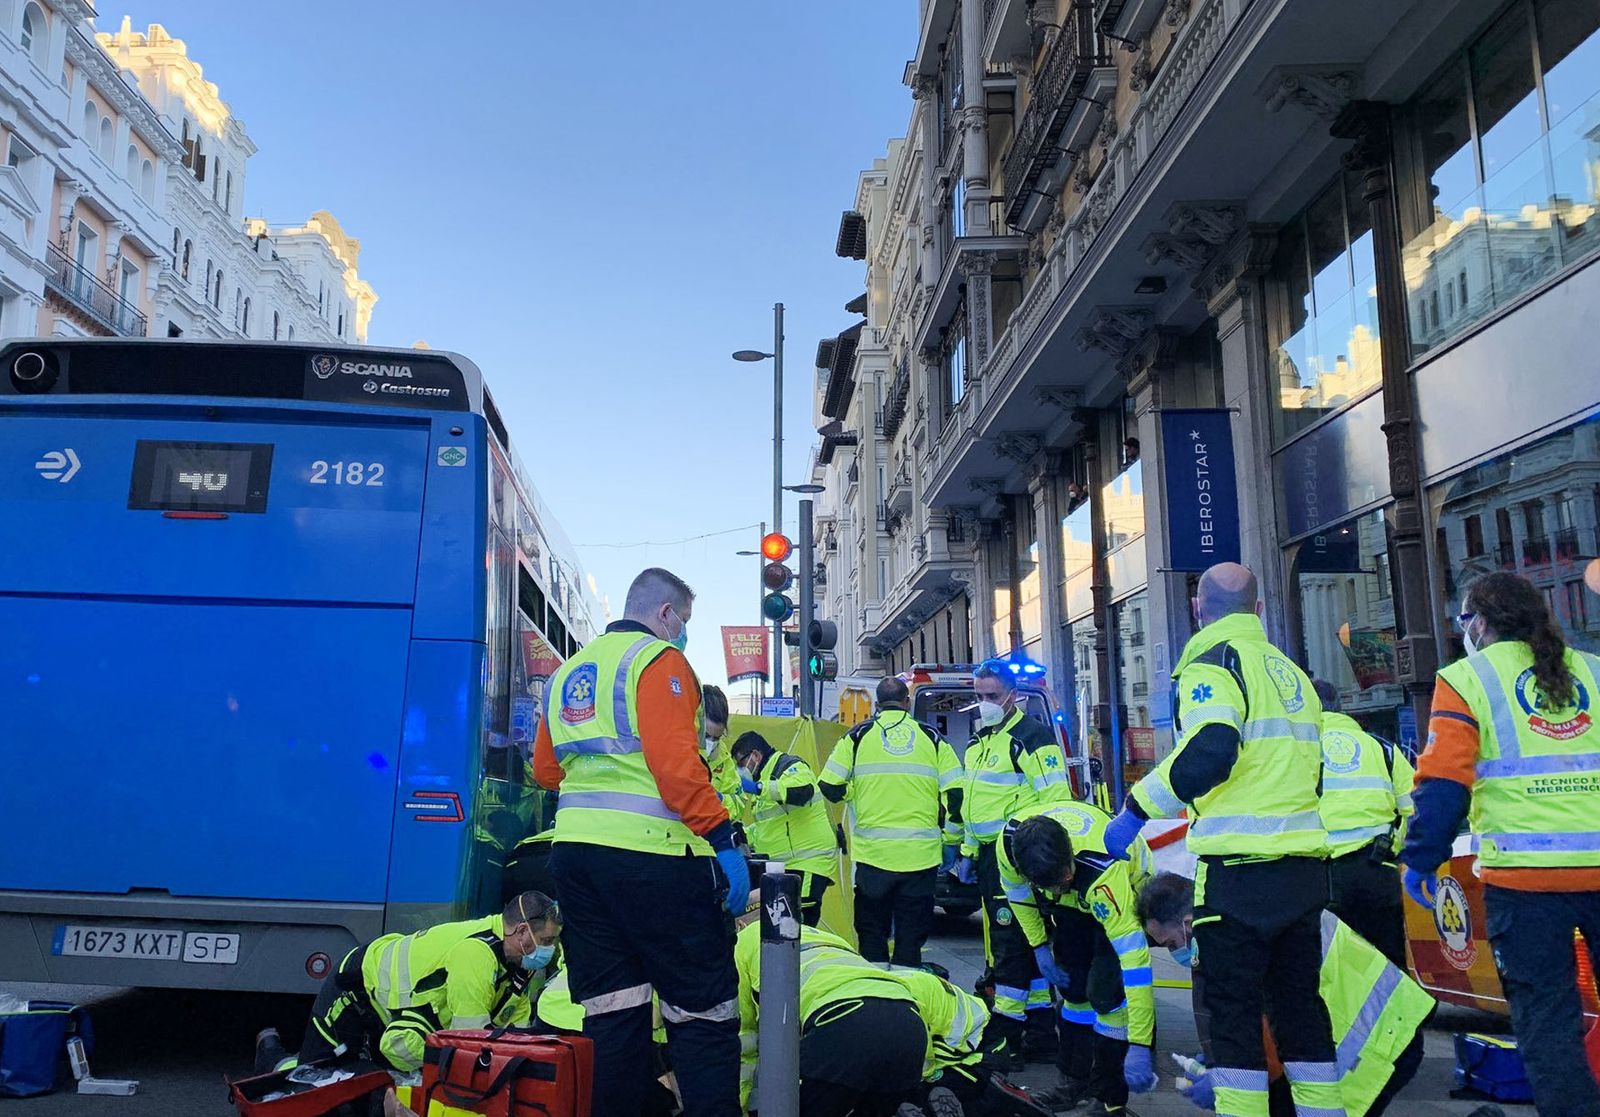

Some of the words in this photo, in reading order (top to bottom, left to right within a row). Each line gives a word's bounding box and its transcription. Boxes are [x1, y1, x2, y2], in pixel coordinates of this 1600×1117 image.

[340, 362, 413, 378] SCANIA
[380, 383, 450, 397] Castrosua
[310, 460, 385, 487] 2182
[1195, 443, 1214, 553] IBEROSTAR
[73, 929, 126, 953] 1673
[132, 932, 178, 956] KXT
[192, 936, 232, 960] SP
